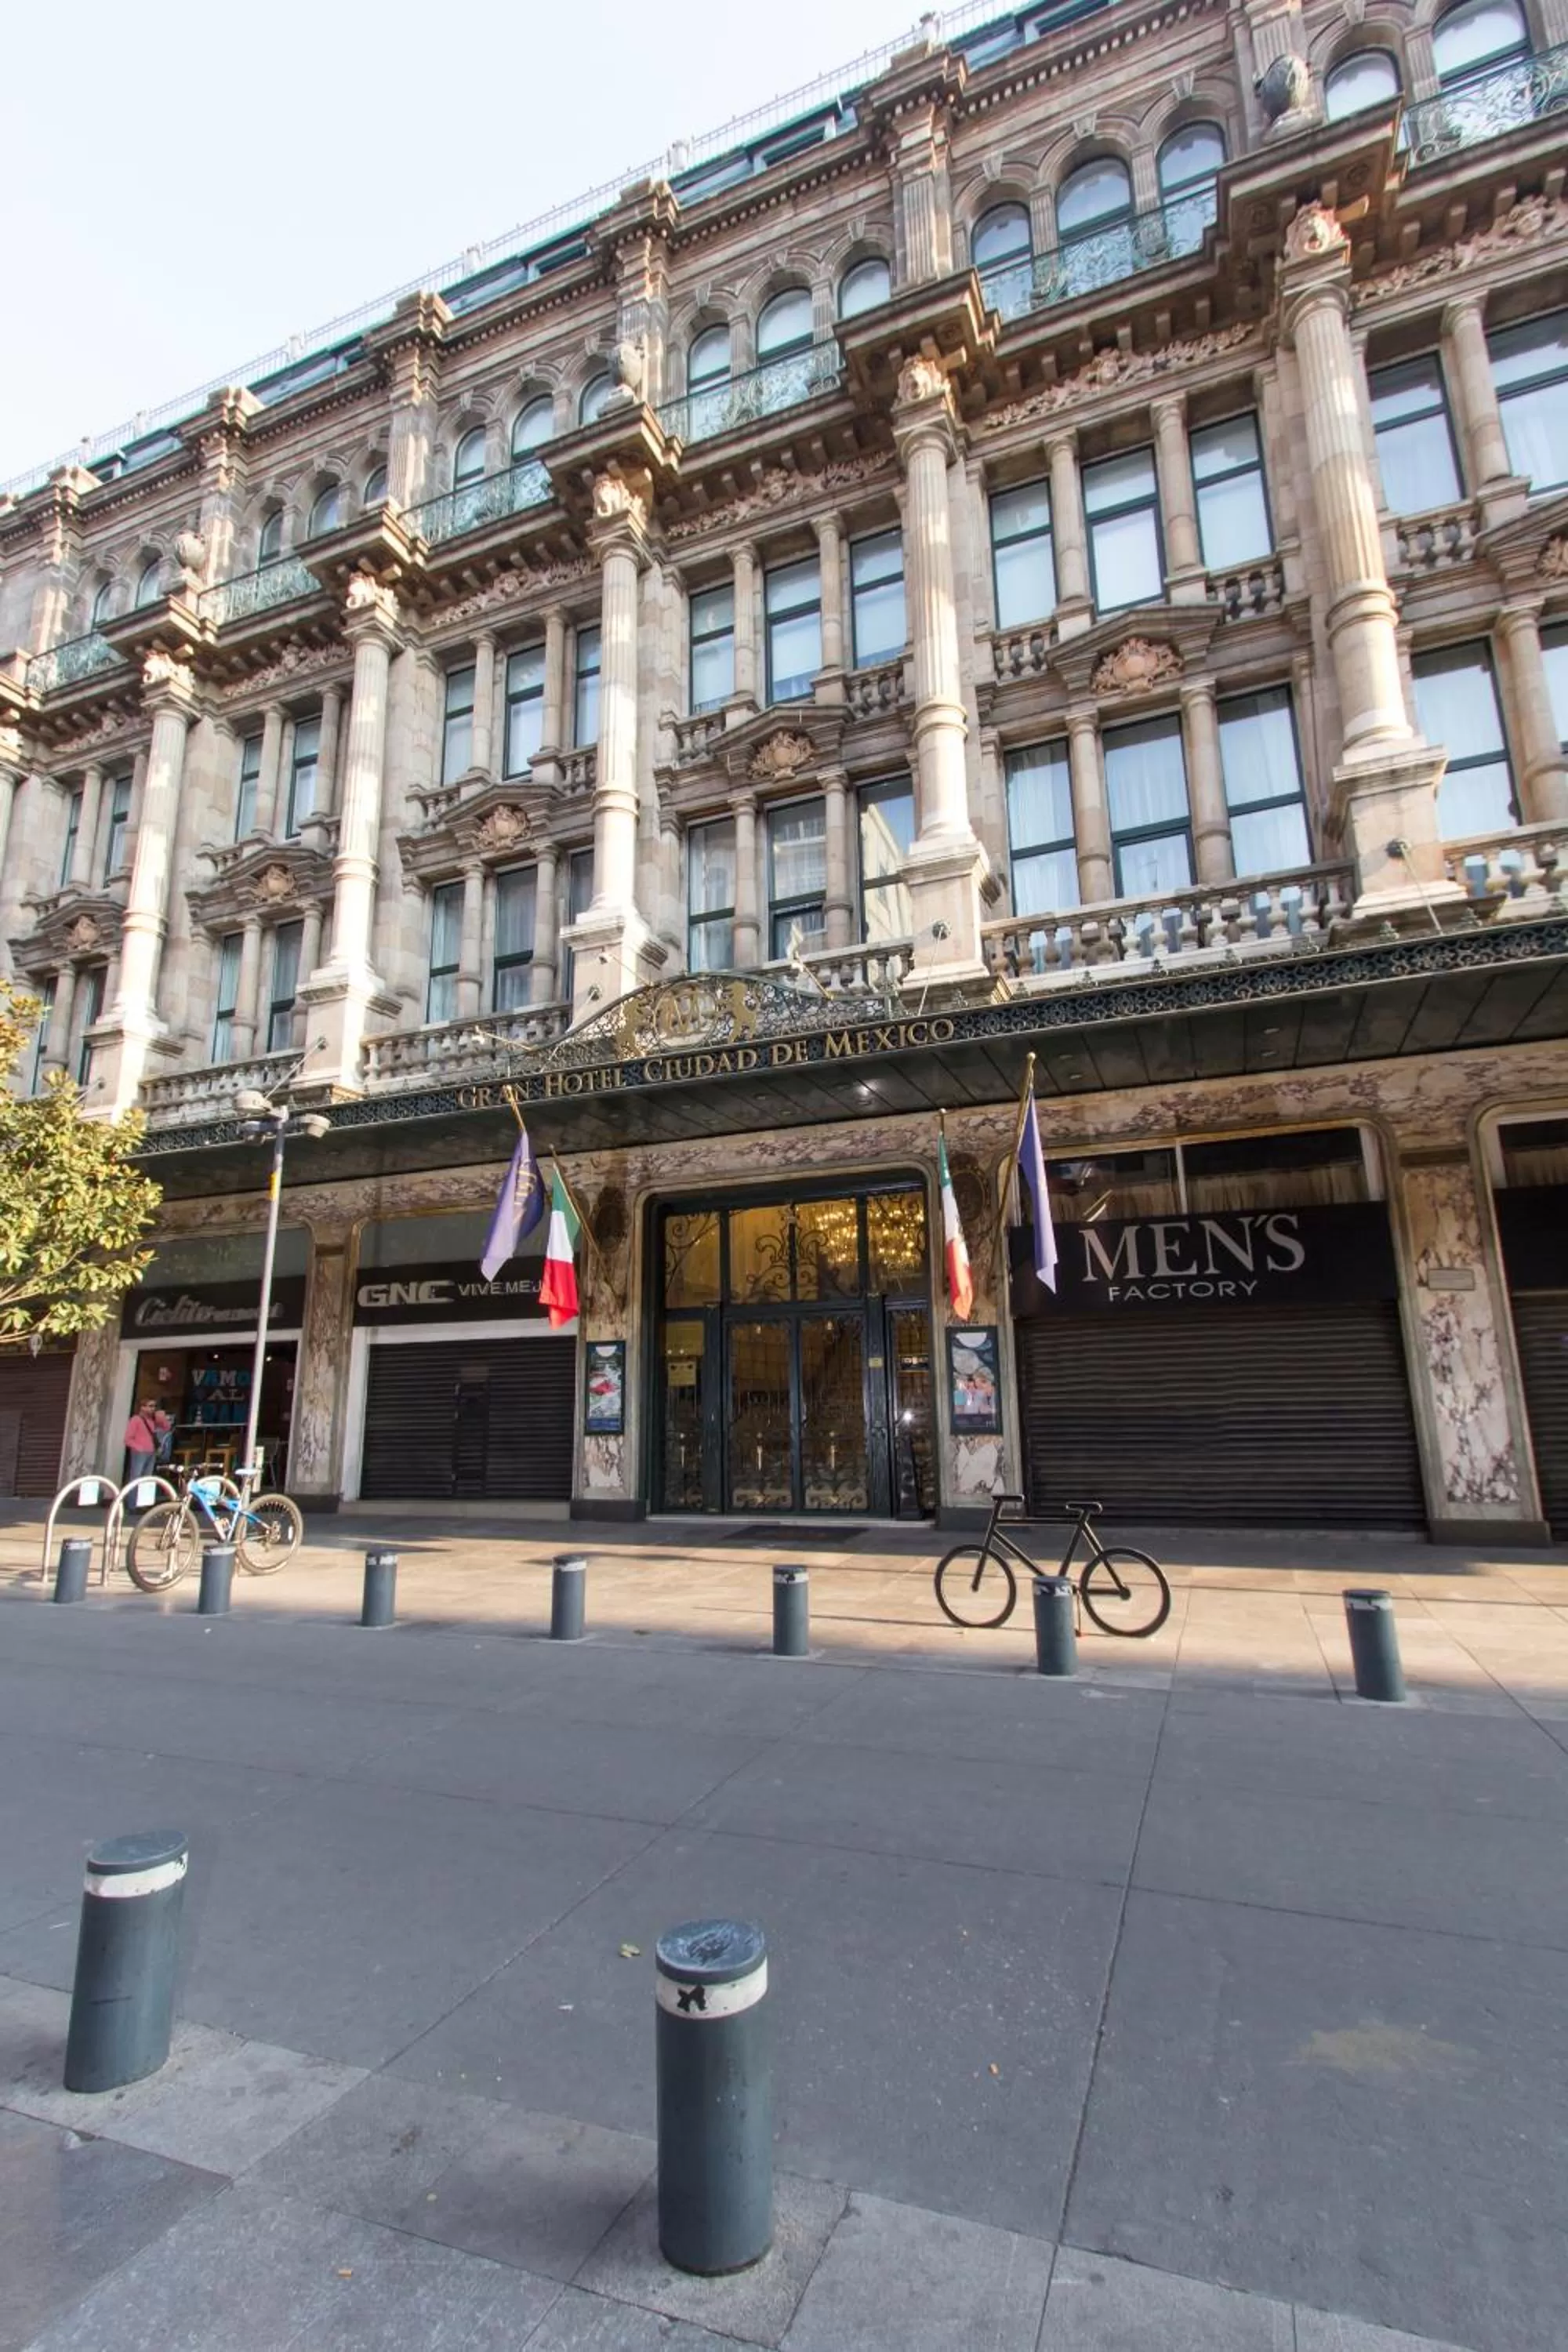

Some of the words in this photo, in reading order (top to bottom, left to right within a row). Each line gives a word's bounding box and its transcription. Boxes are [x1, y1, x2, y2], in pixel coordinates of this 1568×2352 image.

[456, 1080, 531, 1109] GRAN
[544, 1067, 626, 1097] HOTEL
[643, 1047, 757, 1083] CIUDAD
[771, 1040, 808, 1066] DE
[824, 1018, 955, 1058] MEXICO
[358, 1279, 455, 1307] GNC
[457, 1281, 503, 1296] VIVE
[1108, 1280, 1258, 1302] FACTORY
